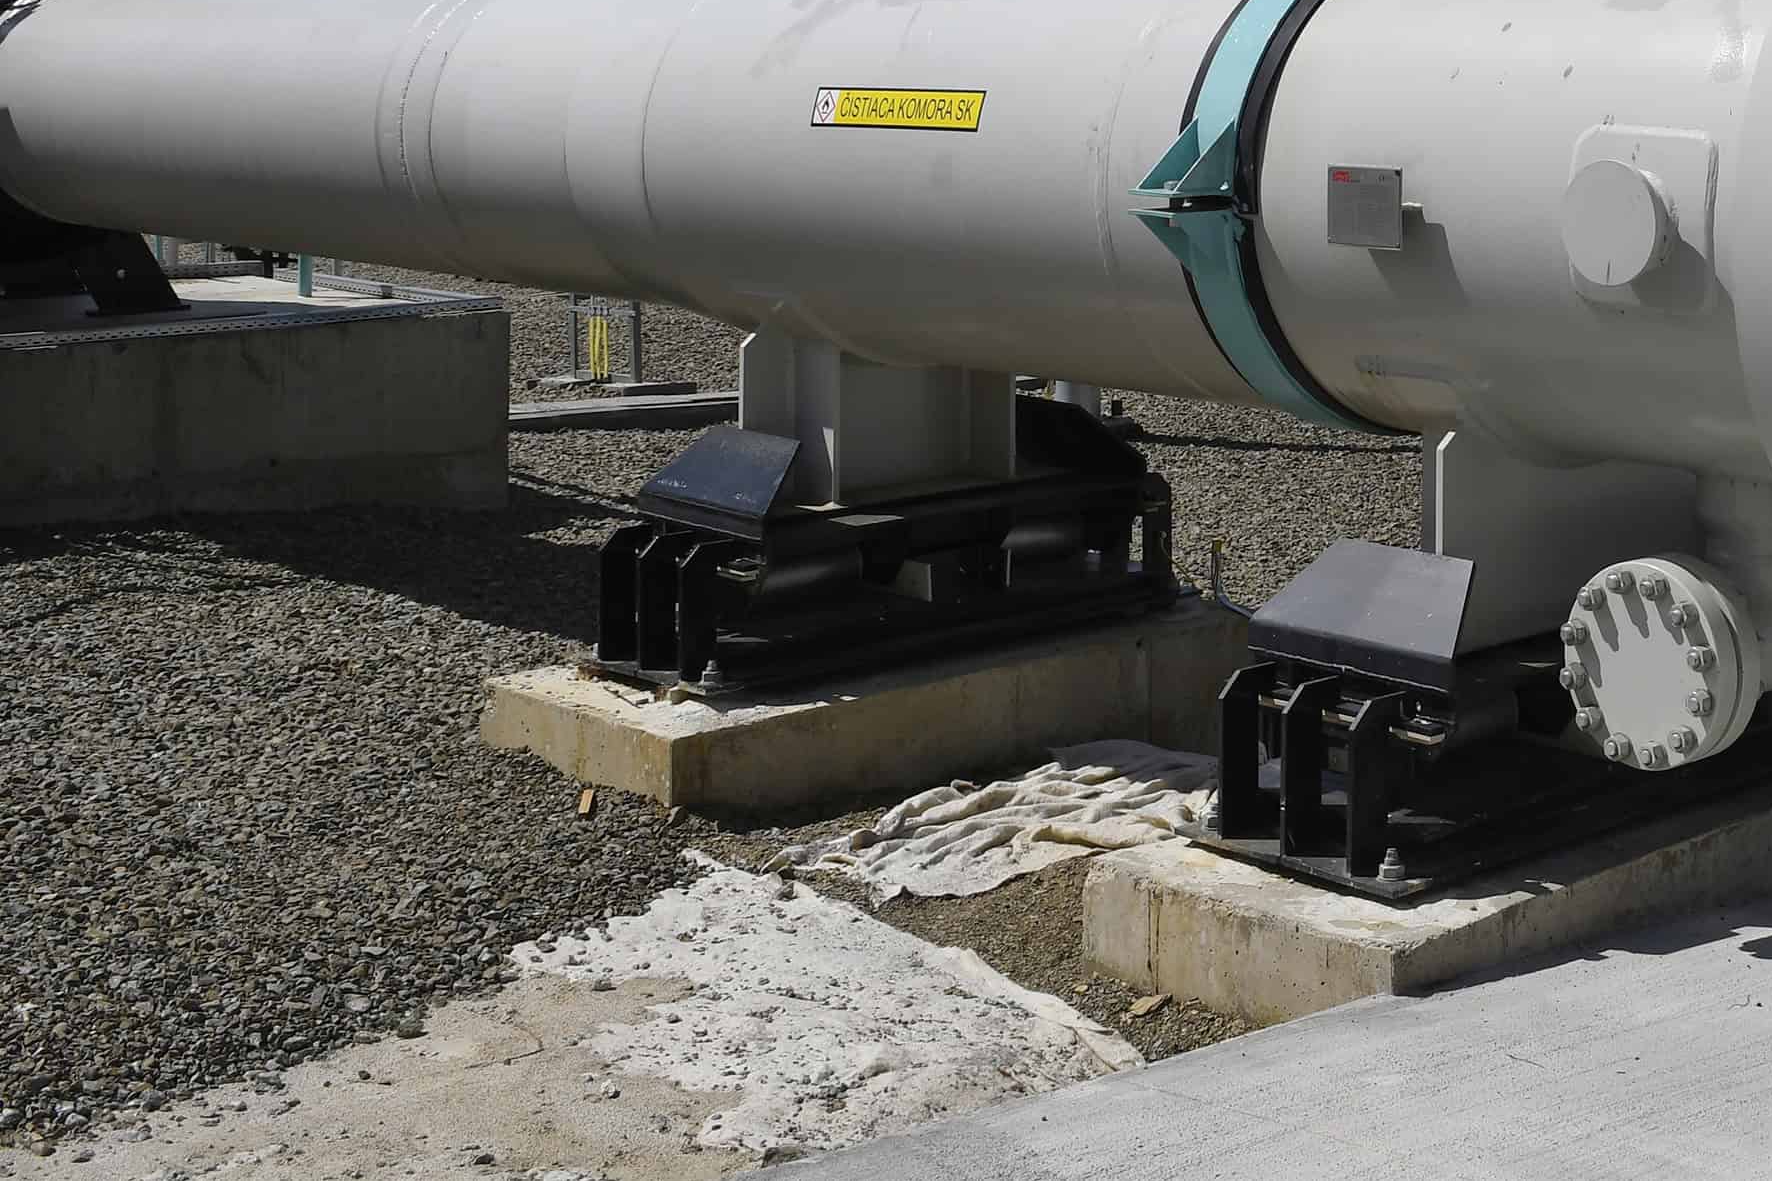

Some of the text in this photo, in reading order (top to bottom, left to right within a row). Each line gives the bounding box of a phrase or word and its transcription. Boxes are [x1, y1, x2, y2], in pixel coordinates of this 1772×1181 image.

[840, 92, 975, 122] ČISTIACA KOMORA SK
